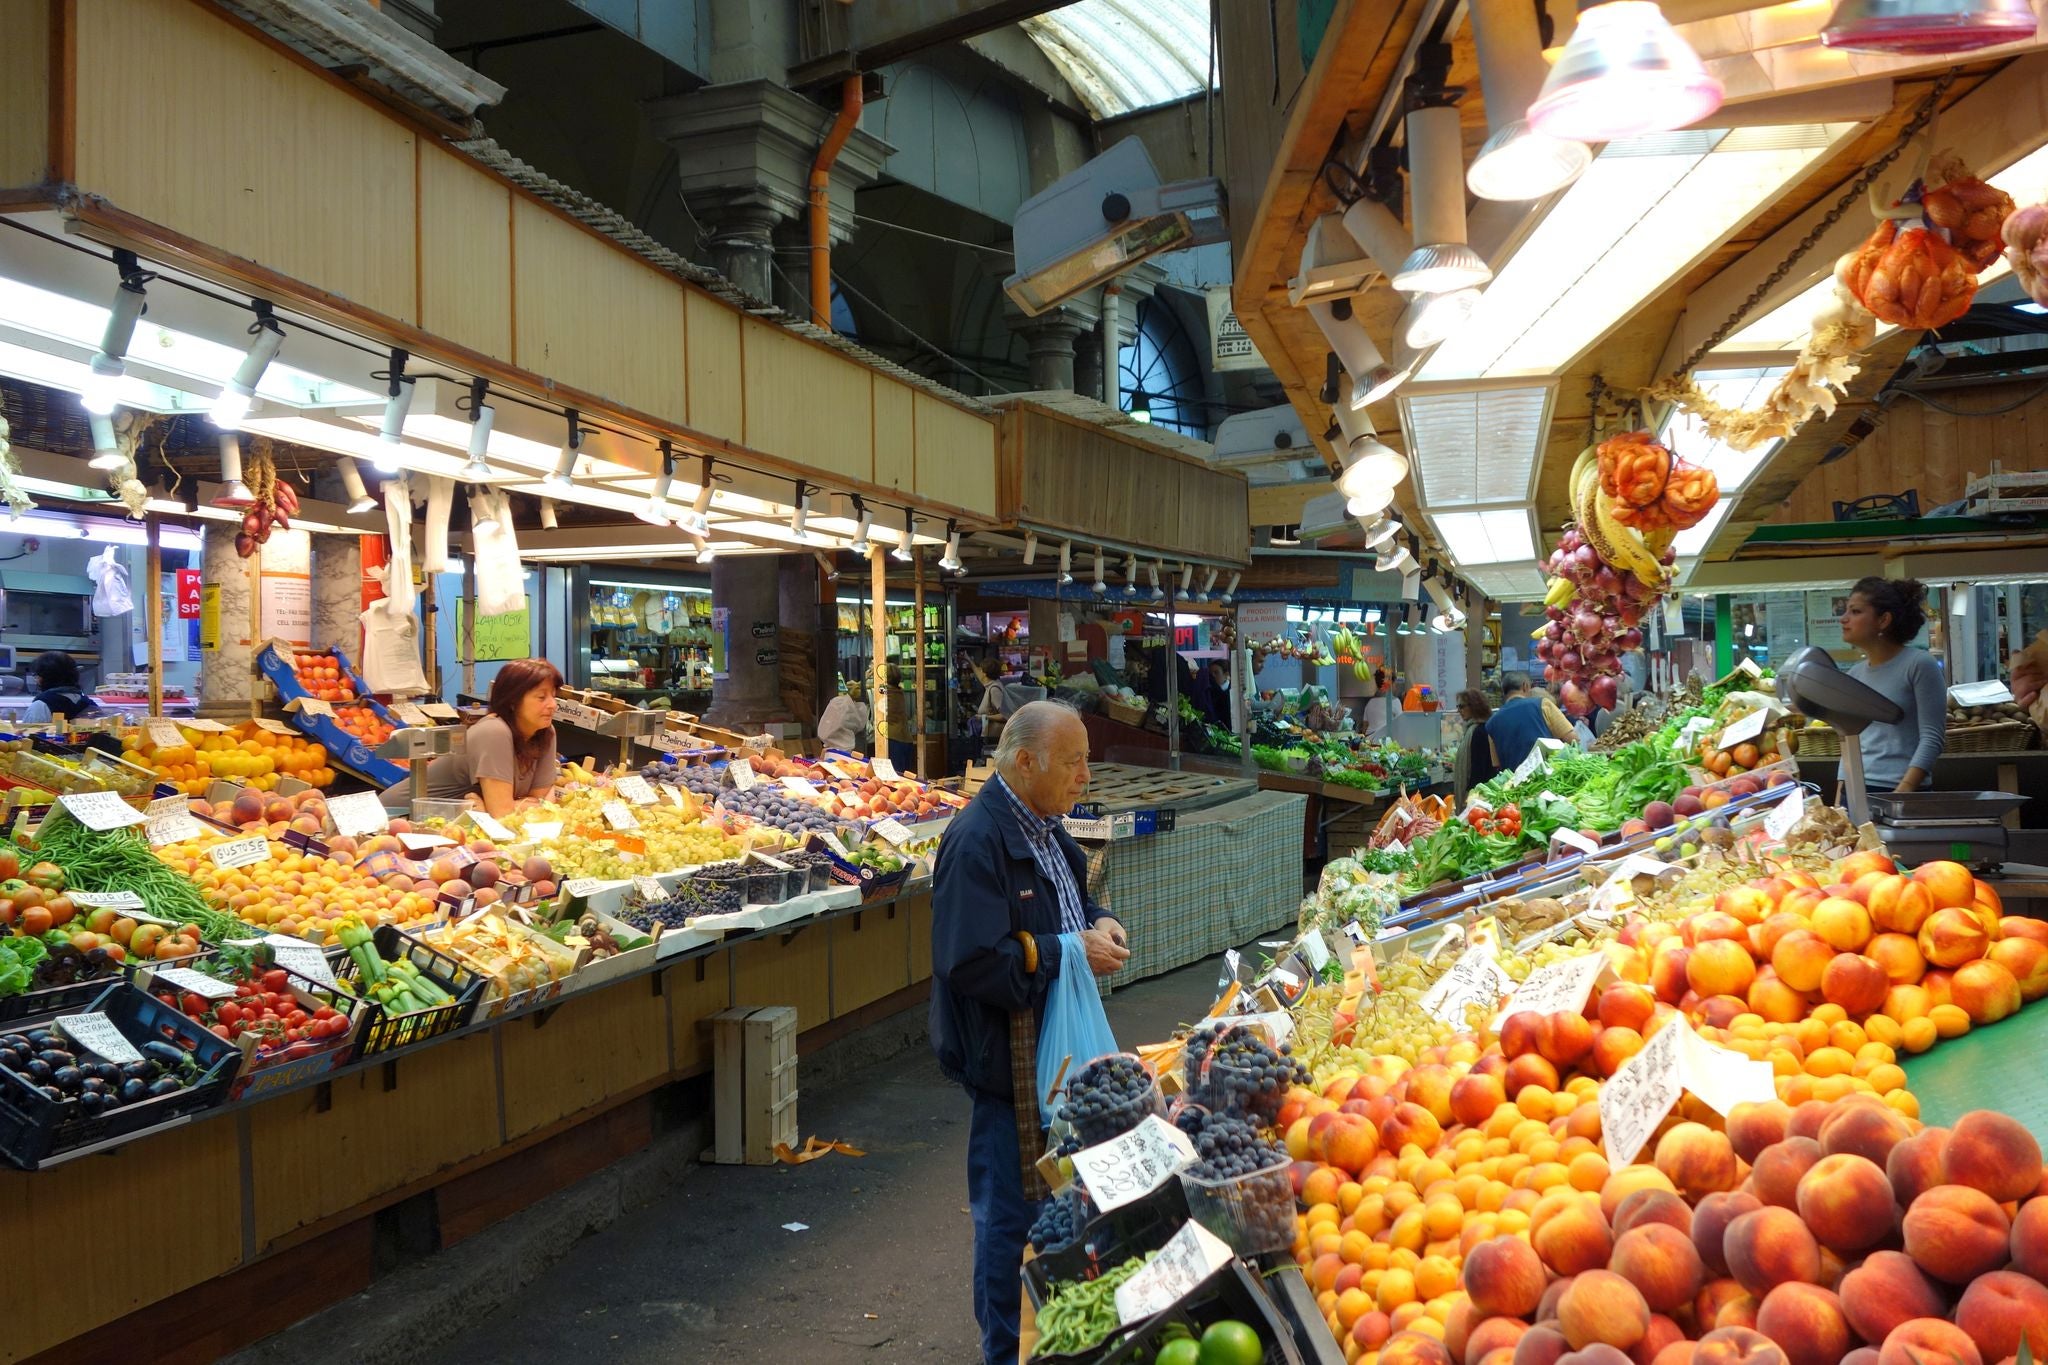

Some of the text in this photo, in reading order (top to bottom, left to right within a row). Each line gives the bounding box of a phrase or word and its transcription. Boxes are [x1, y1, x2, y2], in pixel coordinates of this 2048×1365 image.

[660, 734, 692, 748] Melinda
[216, 840, 265, 860] GUSTOSE
[77, 893, 134, 903] LIGURIA
